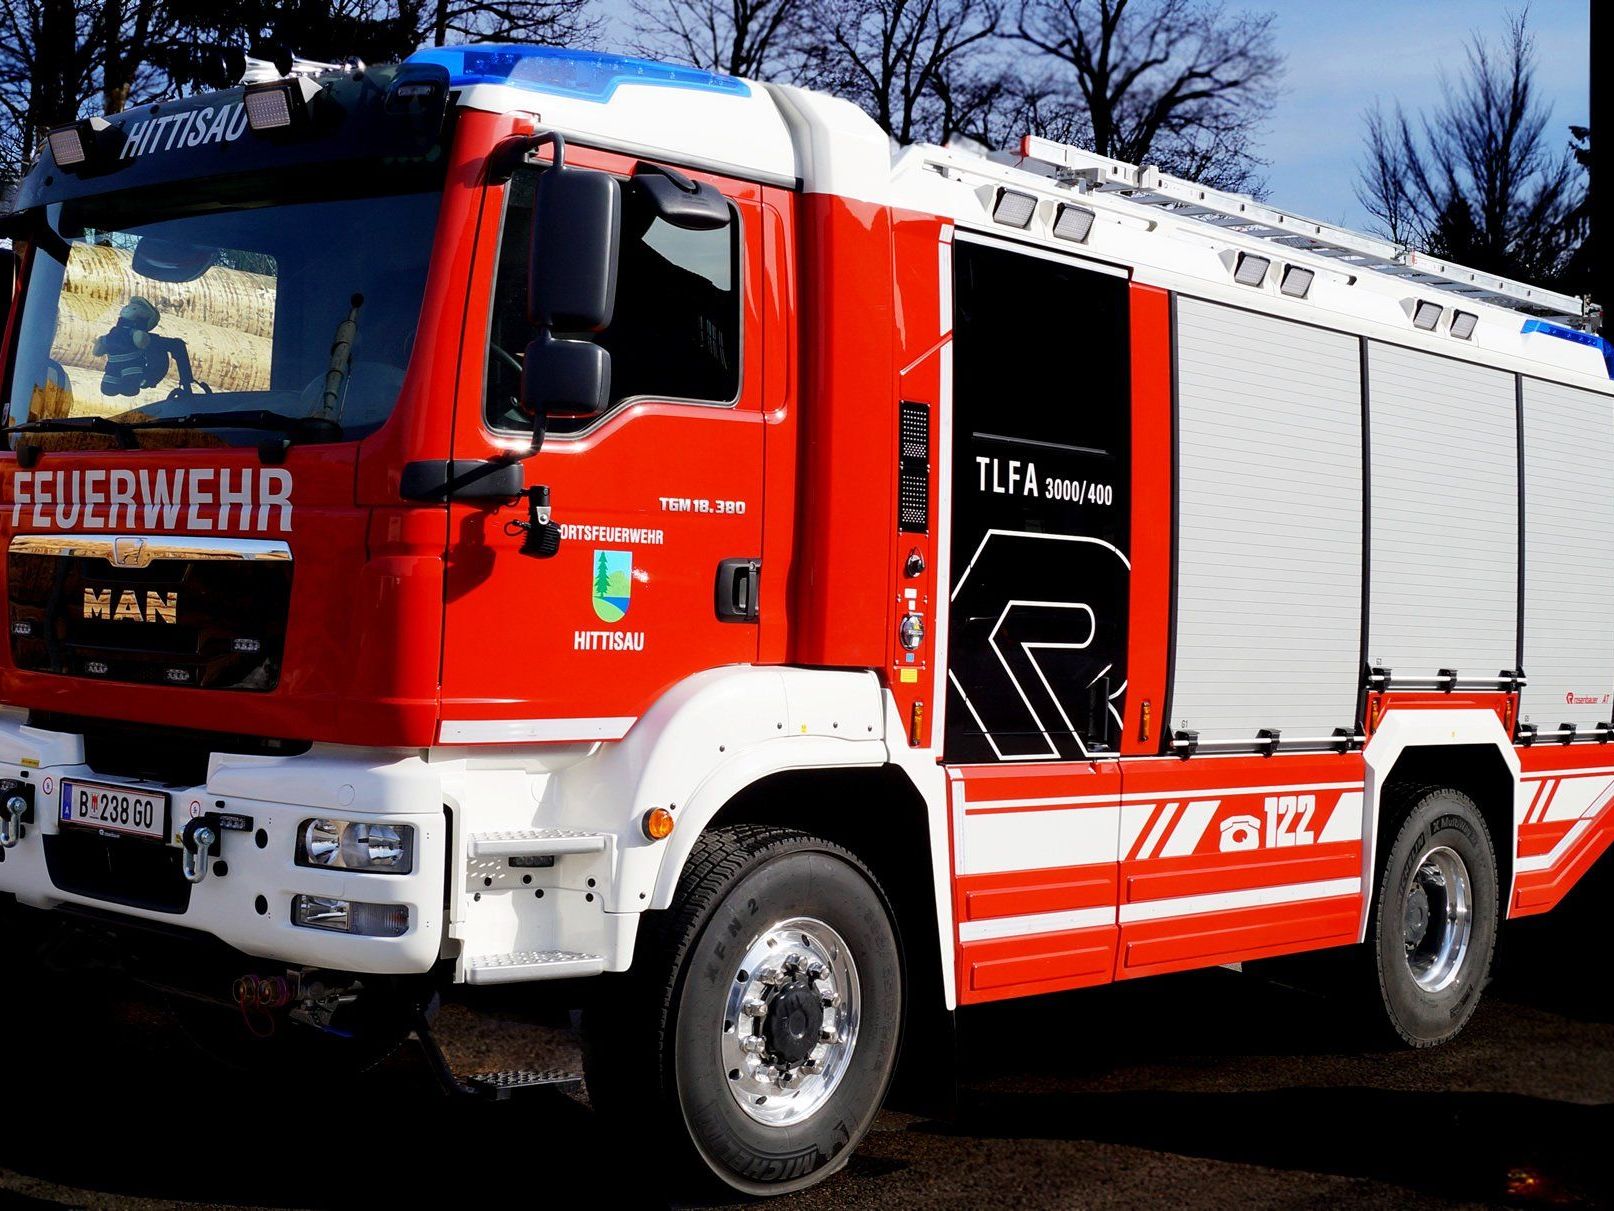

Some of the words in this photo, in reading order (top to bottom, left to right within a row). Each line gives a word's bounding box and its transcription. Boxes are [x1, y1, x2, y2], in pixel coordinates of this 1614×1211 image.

[119, 102, 248, 160] HITTISAU
[11, 467, 294, 532] FEUERWEHR
[975, 456, 1039, 497] TLFA
[1045, 477, 1113, 506] 3000/400
[658, 496, 691, 512] TGM
[693, 499, 746, 515] 18.380
[560, 523, 664, 545] ORTSFEUERWEHR
[82, 587, 179, 625] MAN
[573, 630, 645, 651] HITTISAU
[79, 790, 89, 818] B
[100, 793, 130, 825] 238
[1264, 794, 1316, 849] 122
